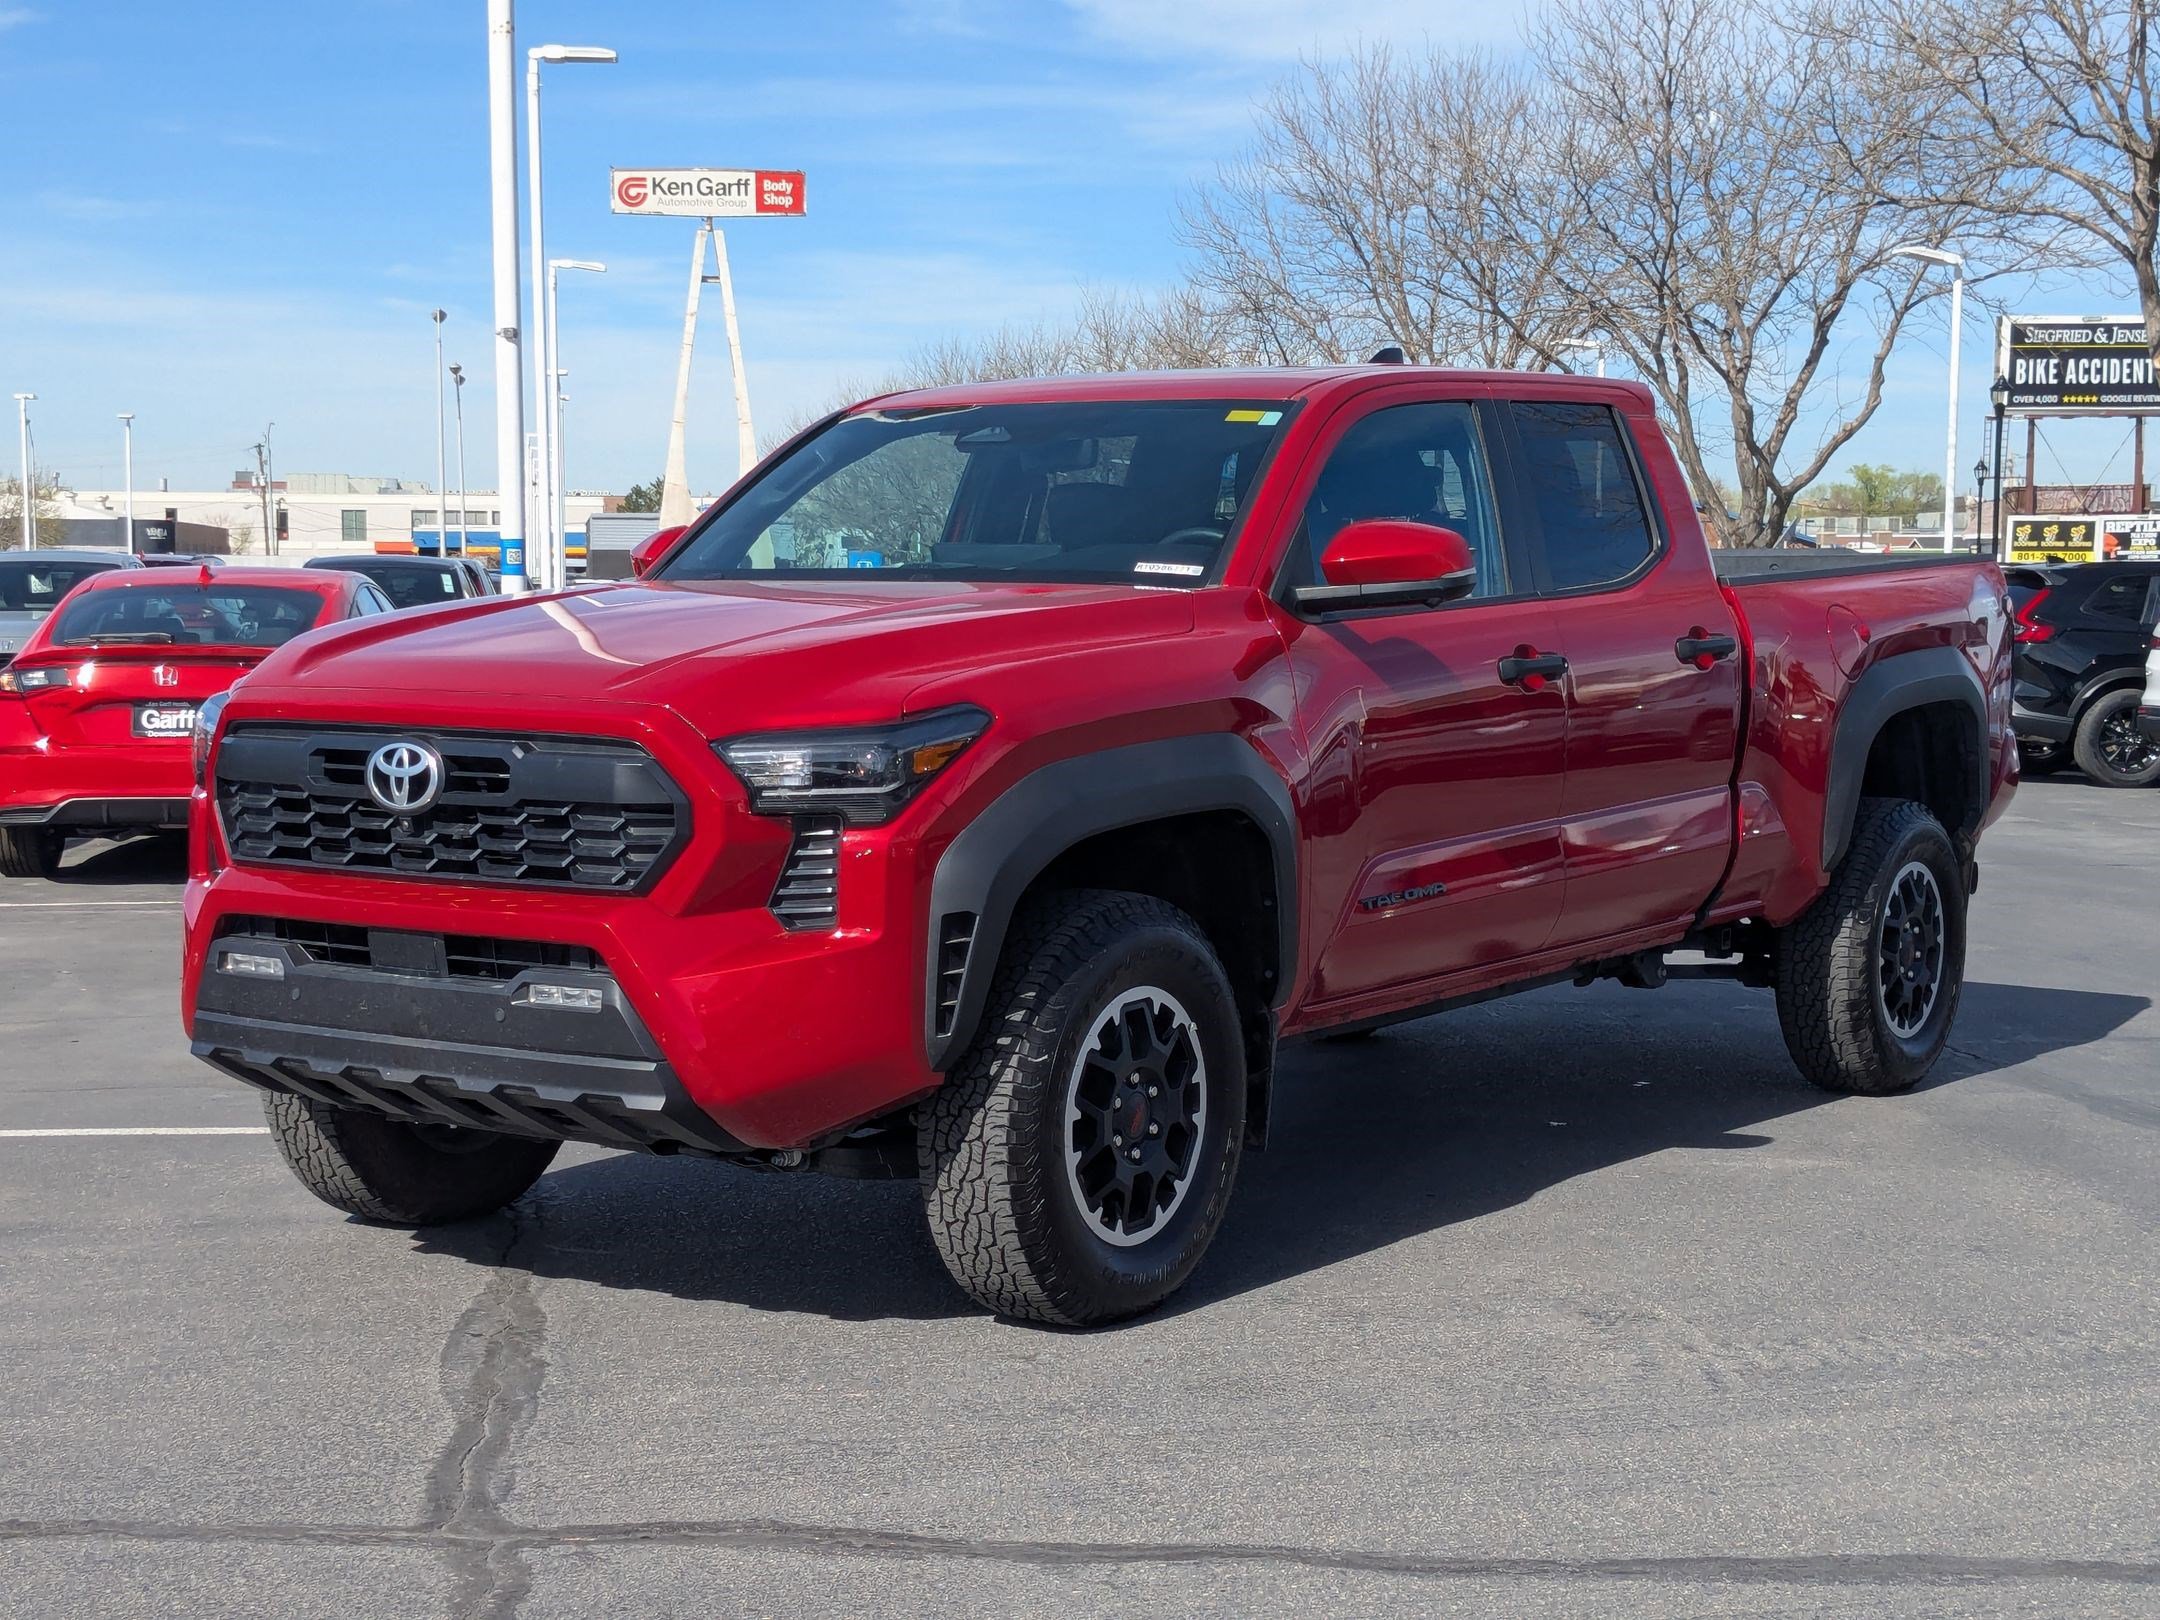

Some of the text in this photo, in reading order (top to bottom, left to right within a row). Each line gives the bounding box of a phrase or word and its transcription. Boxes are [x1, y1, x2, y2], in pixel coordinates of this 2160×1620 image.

[652, 177, 750, 197] Ken Garff
[763, 179, 793, 194] Body
[657, 197, 748, 209] Automotive Group
[763, 193, 793, 208] Shop
[2024, 326, 2092, 343] SIEGFRIED
[2094, 327, 2108, 344] &
[2015, 358, 2154, 385] BIKE ACCIDENT
[2012, 395, 2034, 403] OVER
[2035, 395, 2058, 404] 4,000
[2100, 395, 2132, 403] GOOGLE
[141, 709, 196, 730] Garff
[1361, 882, 1448, 910] TACOMA
